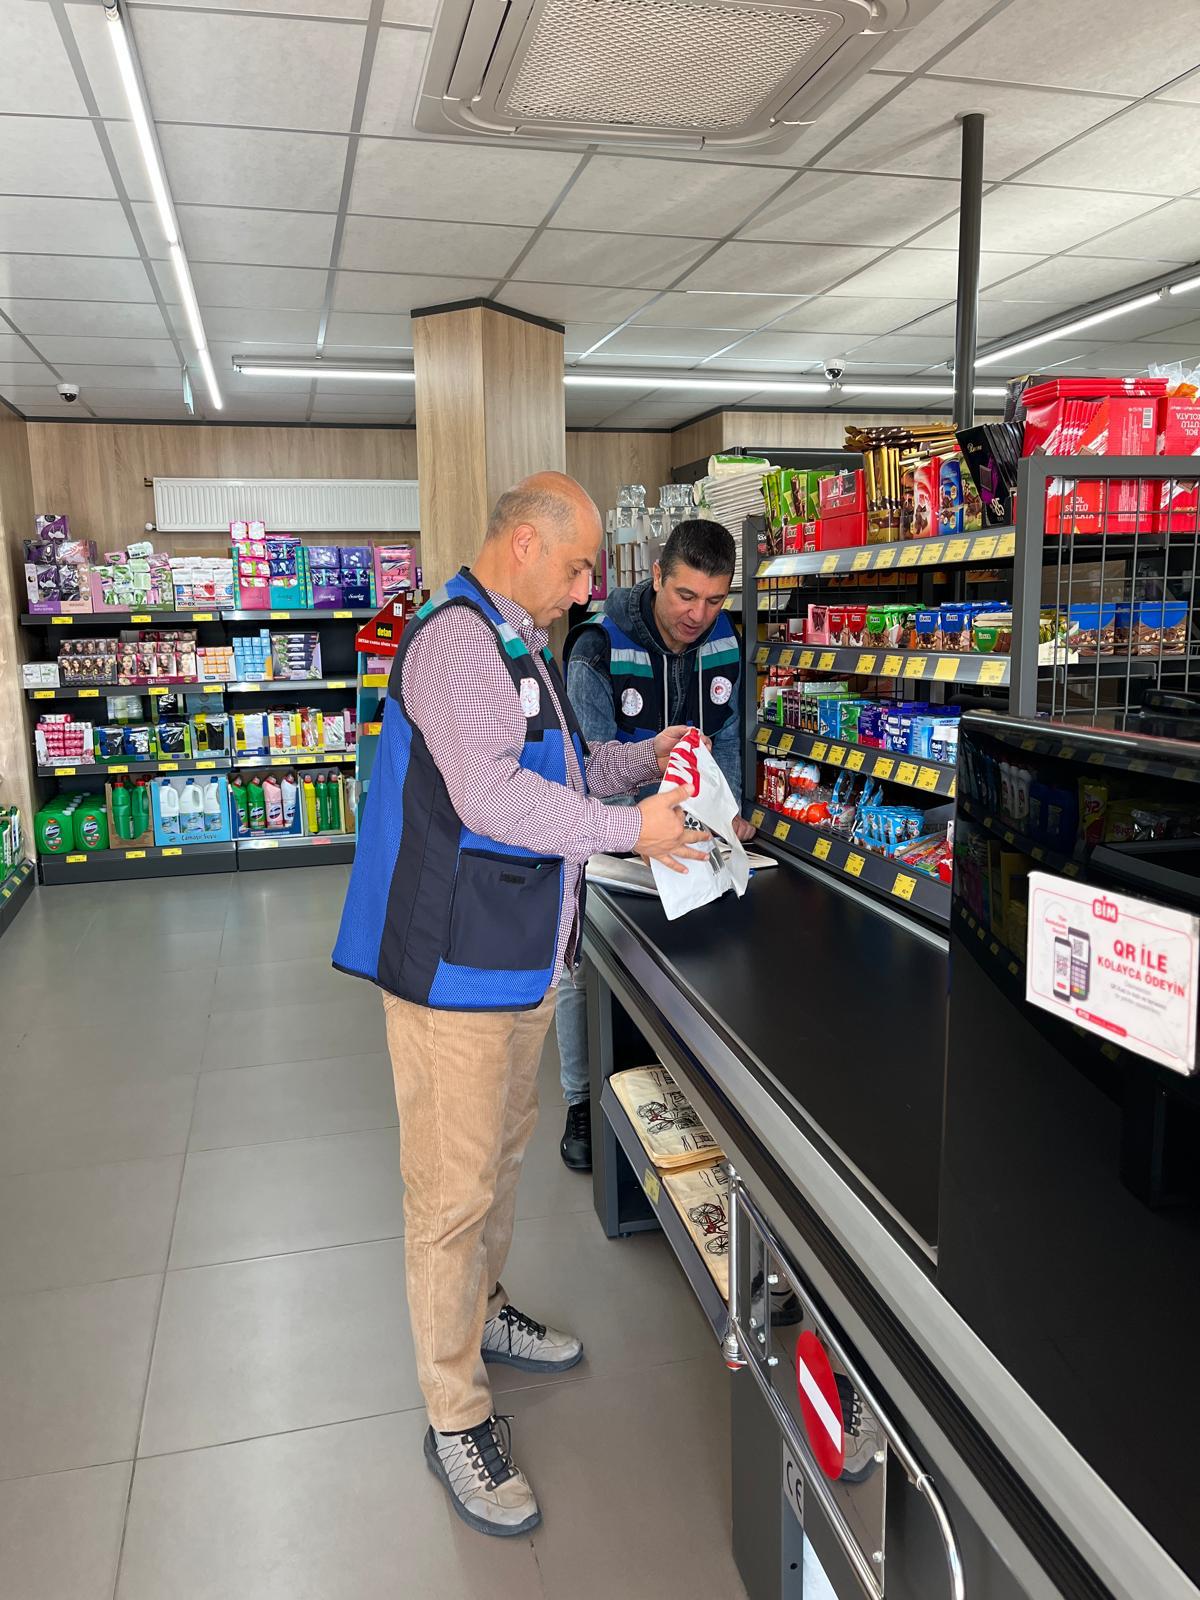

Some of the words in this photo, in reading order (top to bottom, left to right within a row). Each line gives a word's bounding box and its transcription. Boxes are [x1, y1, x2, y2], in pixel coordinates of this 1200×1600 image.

[1094, 895, 1117, 922] BİM
[1113, 938, 1136, 962] QR
[1140, 942, 1168, 974] İLE
[1097, 955, 1142, 982] KOLAYCA
[1144, 969, 1185, 998] ÖDEYİN
